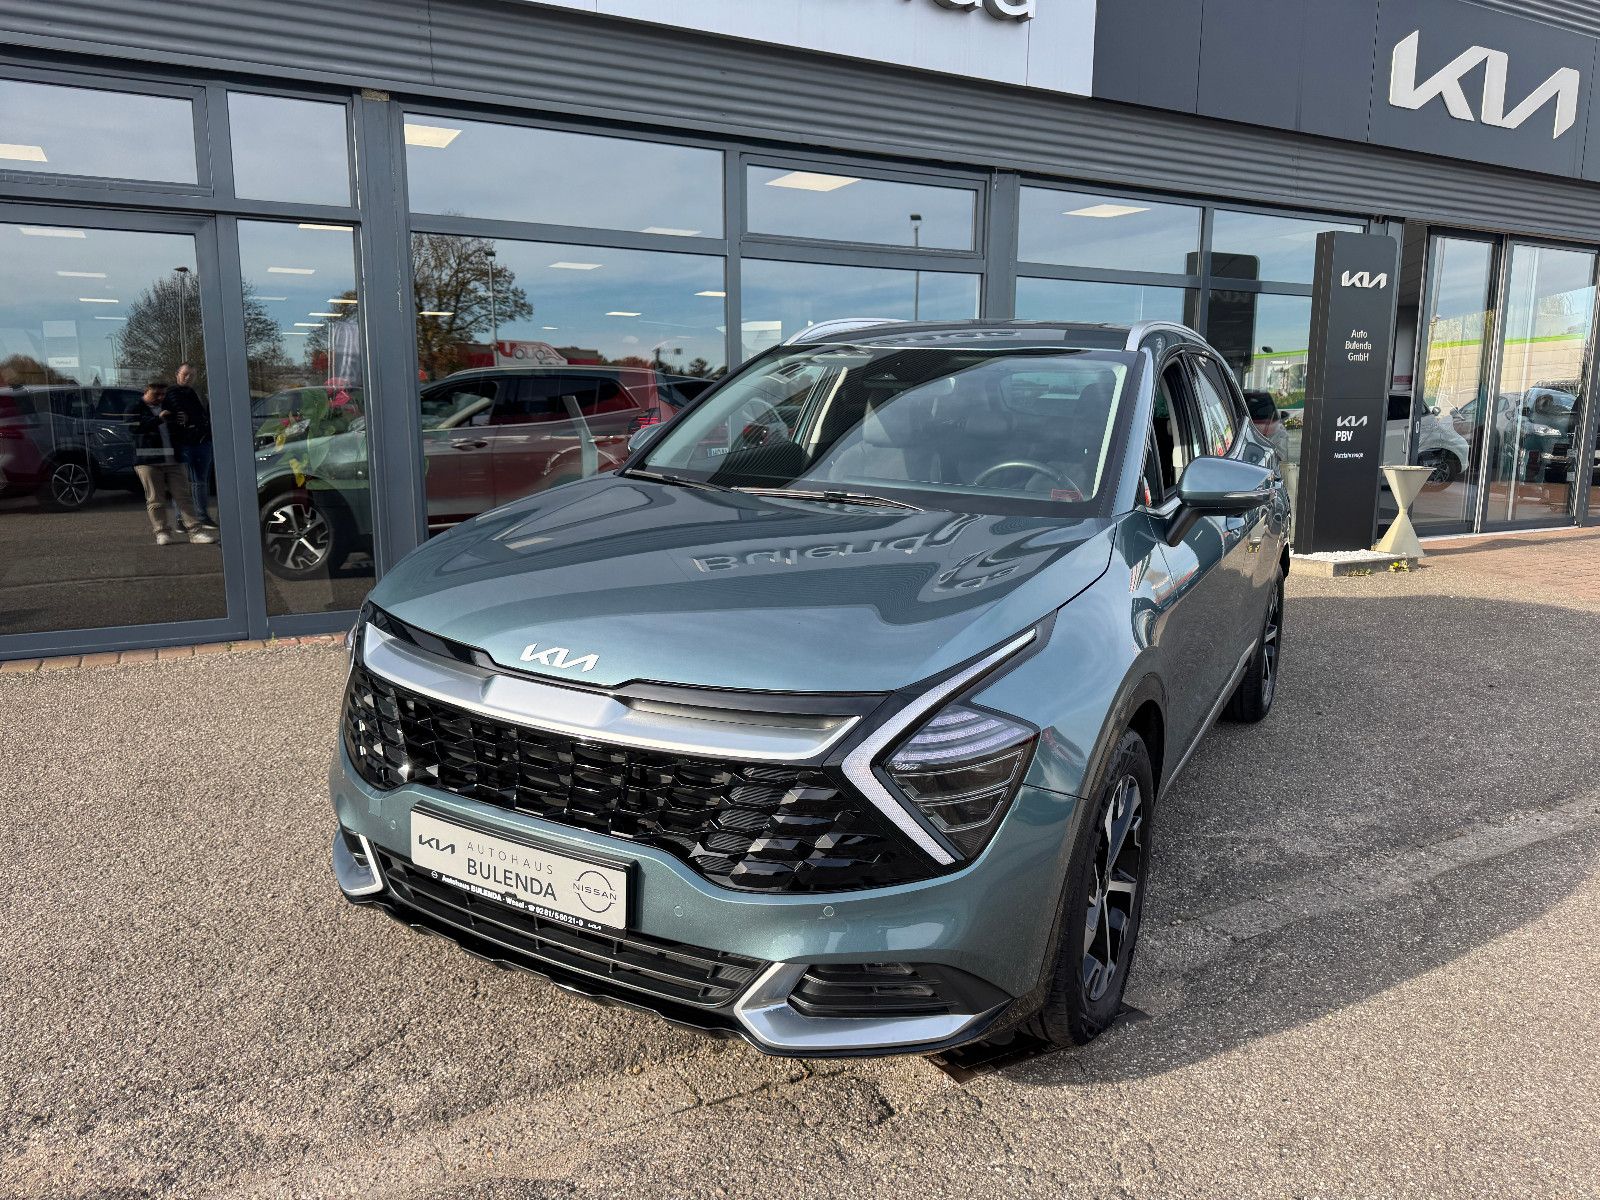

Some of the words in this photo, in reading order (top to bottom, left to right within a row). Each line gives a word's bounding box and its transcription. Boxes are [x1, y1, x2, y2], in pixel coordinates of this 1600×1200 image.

[1389, 29, 1580, 139] KIA
[1341, 270, 1387, 289] KIA
[1351, 329, 1367, 338] Auto
[1345, 340, 1372, 350] Bulenda
[1348, 352, 1369, 361] GmbH
[1336, 415, 1368, 427] KIA
[1335, 430, 1353, 442] PBV
[519, 642, 600, 673] KIA
[418, 833, 456, 855] KIA
[467, 841, 554, 875] AUTOHAUS
[441, 874, 470, 891] Autohaus
[470, 884, 503, 902] BULENDA
[467, 857, 558, 902] BULENDA
[572, 882, 617, 901] NISSAN
